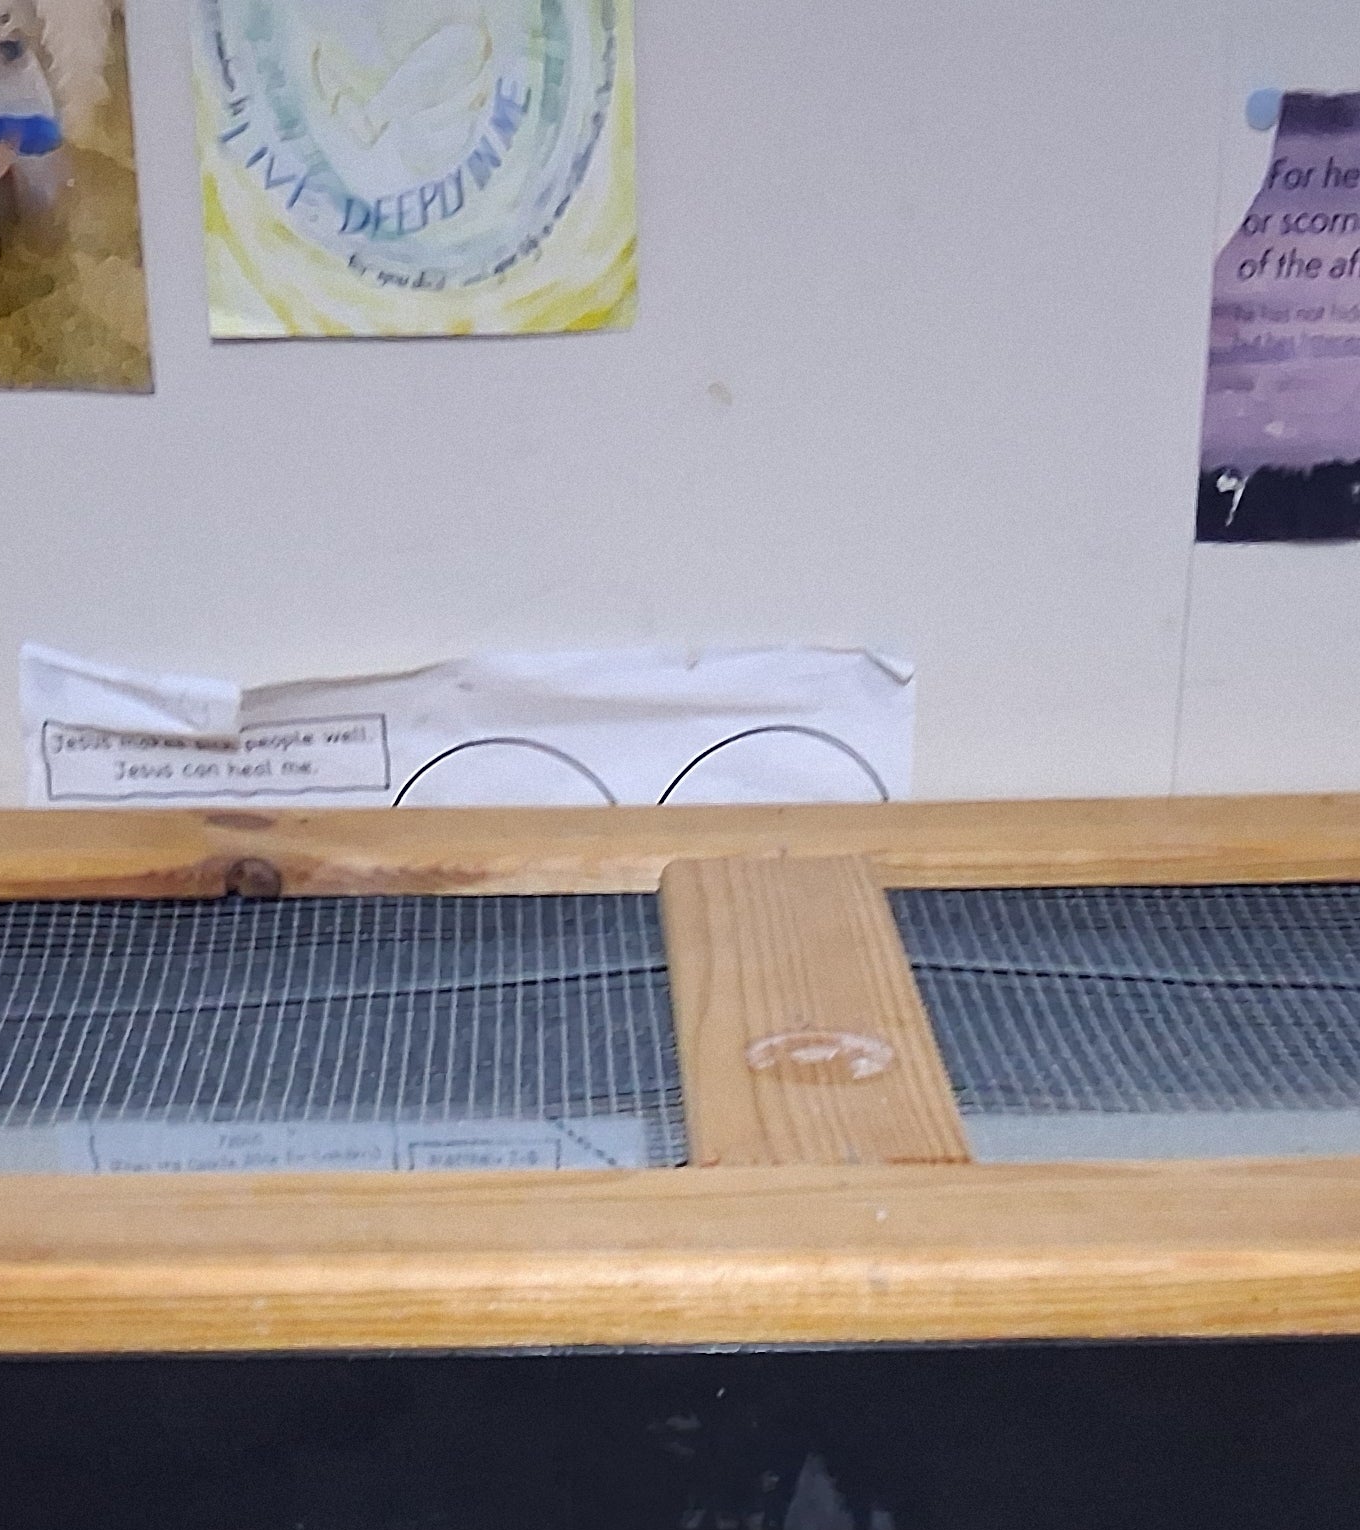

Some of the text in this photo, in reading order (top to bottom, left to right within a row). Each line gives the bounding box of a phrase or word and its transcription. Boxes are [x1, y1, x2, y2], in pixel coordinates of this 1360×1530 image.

[1267, 155, 1316, 190] For
[1323, 156, 1360, 189] he
[1241, 212, 1273, 236] or
[1239, 246, 1274, 281] of
[1276, 248, 1322, 279] the
